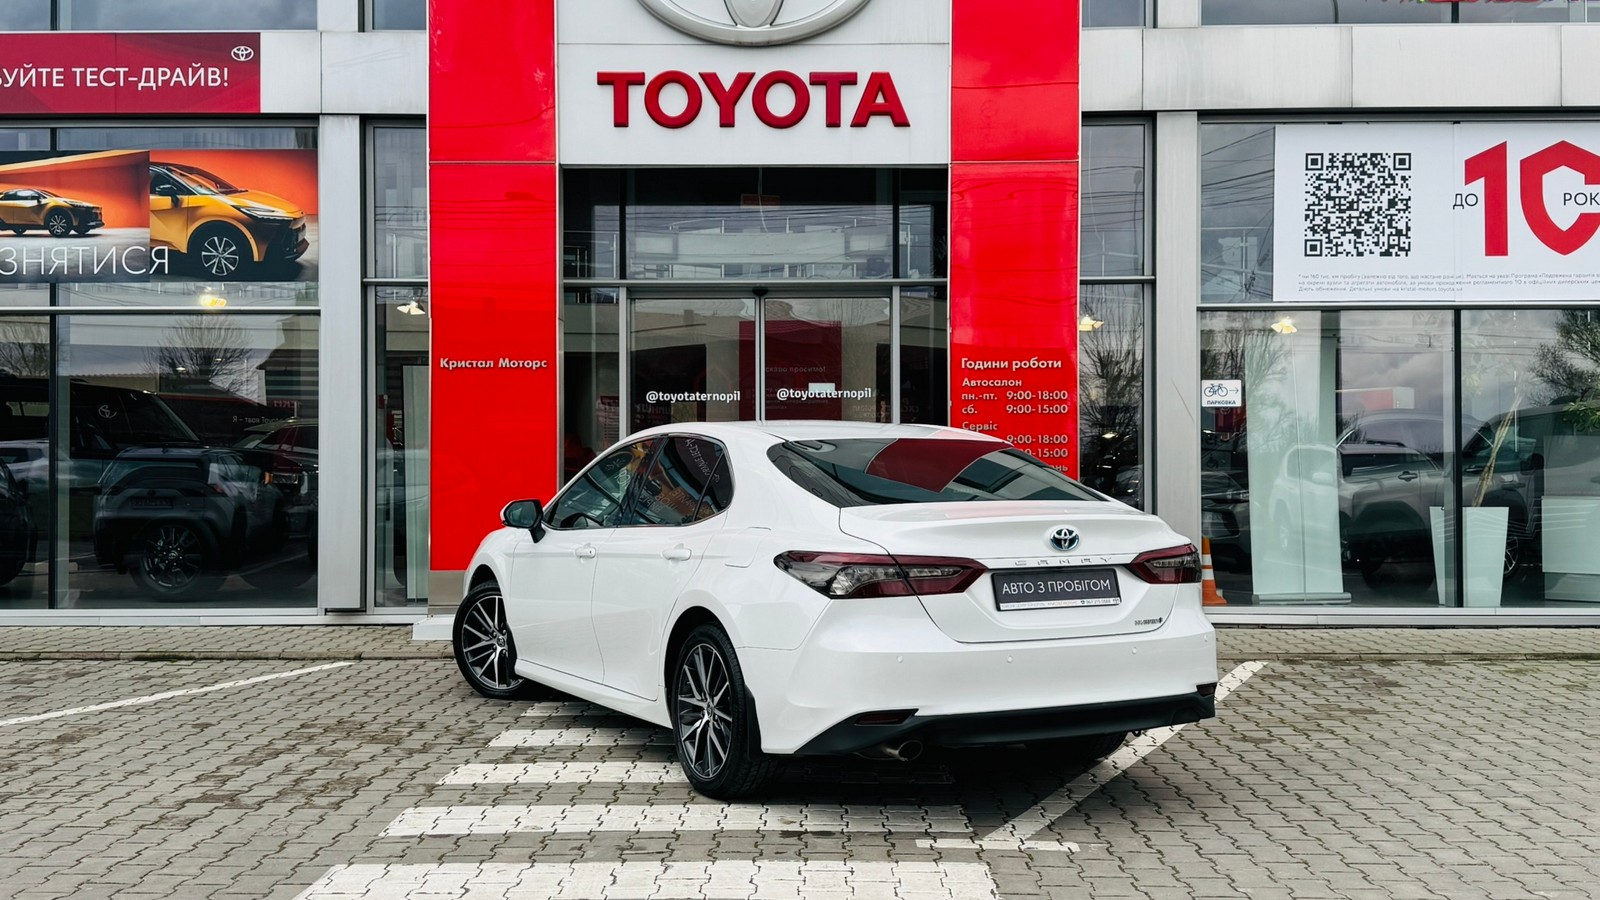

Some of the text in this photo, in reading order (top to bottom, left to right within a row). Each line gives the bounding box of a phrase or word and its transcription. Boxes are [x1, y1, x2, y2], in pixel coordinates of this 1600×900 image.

[0, 63, 228, 91] УЙТЕ ТЕСТ-ДРАЙВ!
[597, 70, 911, 129] TOYOTA
[1452, 193, 1479, 210] ДО
[0, 246, 169, 275] ЗНЯТИСЯ
[440, 357, 548, 370] Кристал Моторс
[961, 356, 1062, 372] Години роботи
[962, 377, 1022, 387] Автосалон
[645, 390, 741, 404] @toyotaternopil
[777, 387, 872, 401] @toyotaternopil
[1006, 390, 1069, 400] 9:00-18:00
[962, 403, 1069, 414] сб. 9:00-15:00
[962, 420, 998, 432] Сервіс
[1002, 579, 1111, 595] АВТО З ПРОБІГОМ
